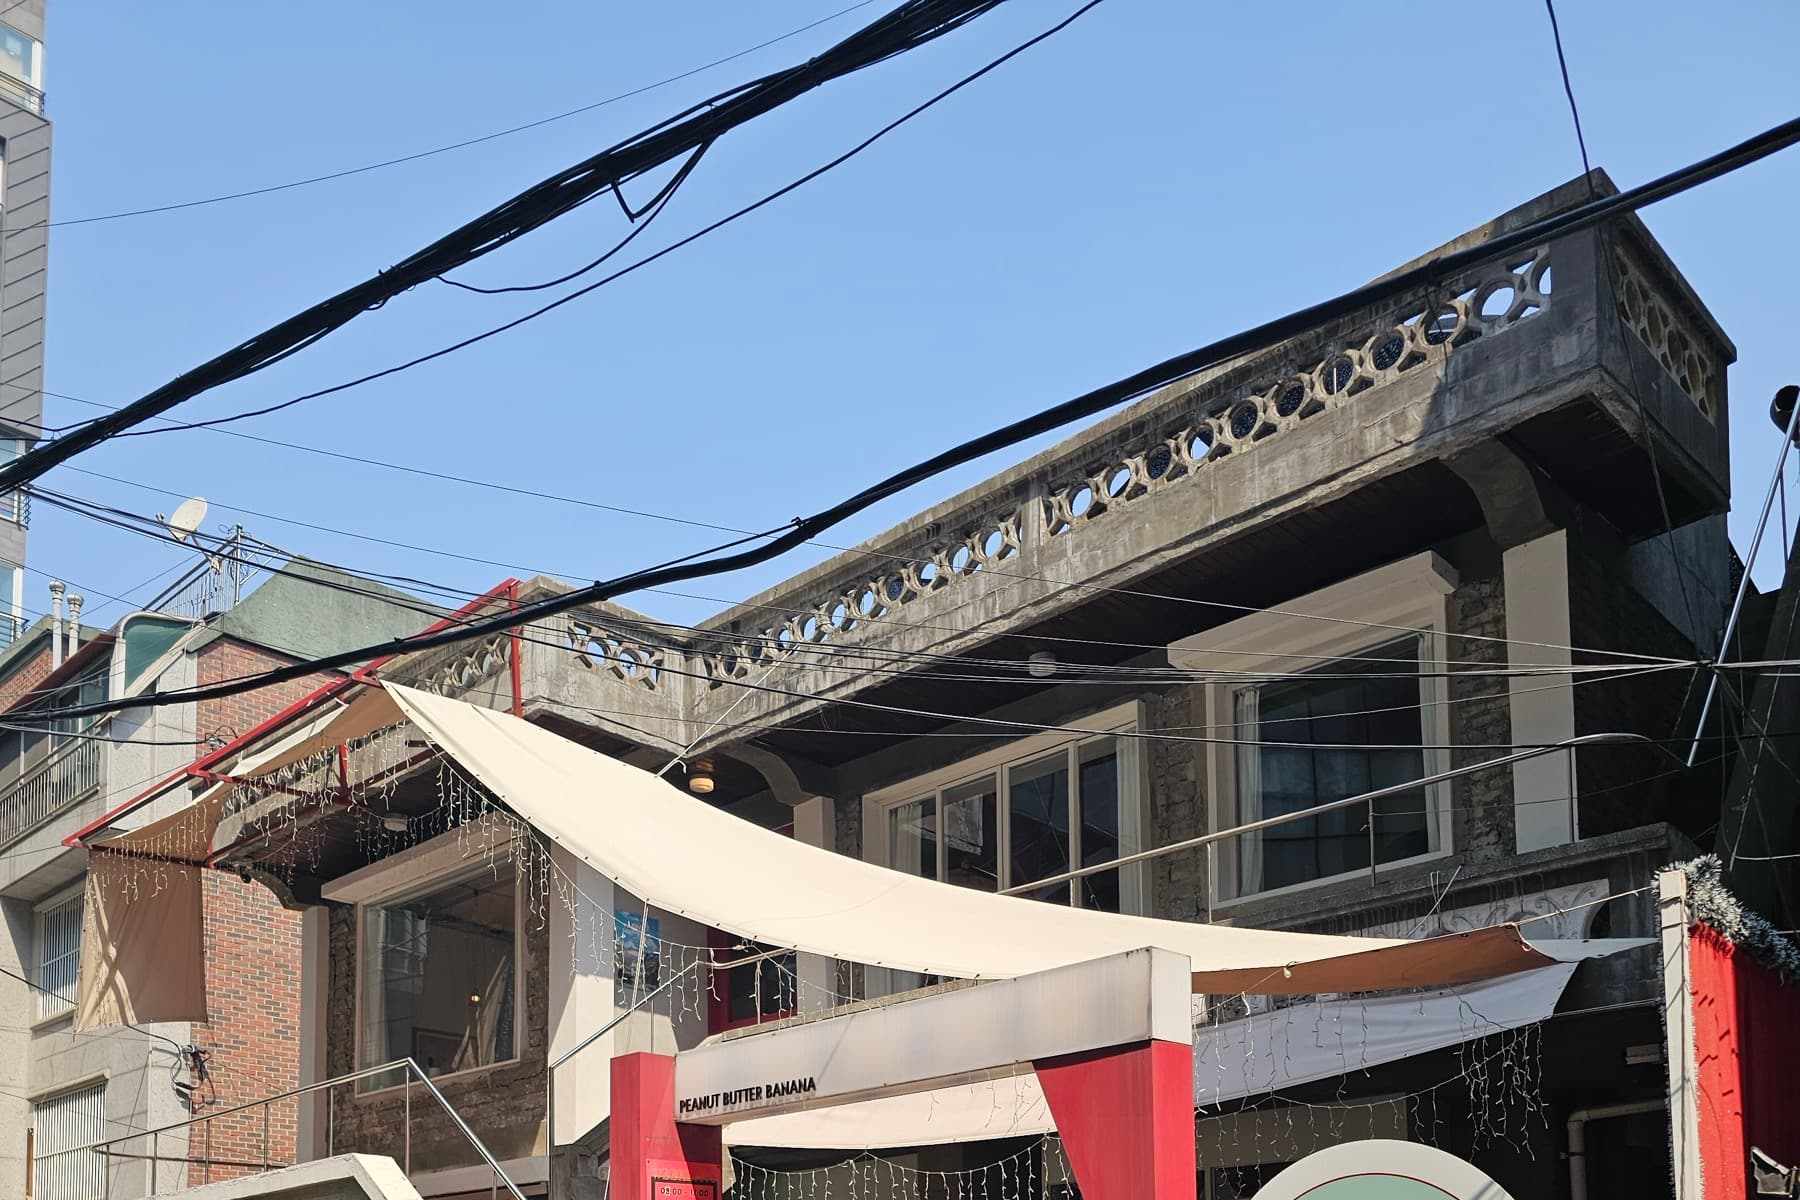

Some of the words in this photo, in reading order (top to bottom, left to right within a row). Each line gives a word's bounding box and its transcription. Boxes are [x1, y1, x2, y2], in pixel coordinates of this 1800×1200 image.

[680, 1093, 720, 1113] PEANUT
[723, 1086, 763, 1106] BUTTER
[765, 1077, 816, 1099] BANANA
